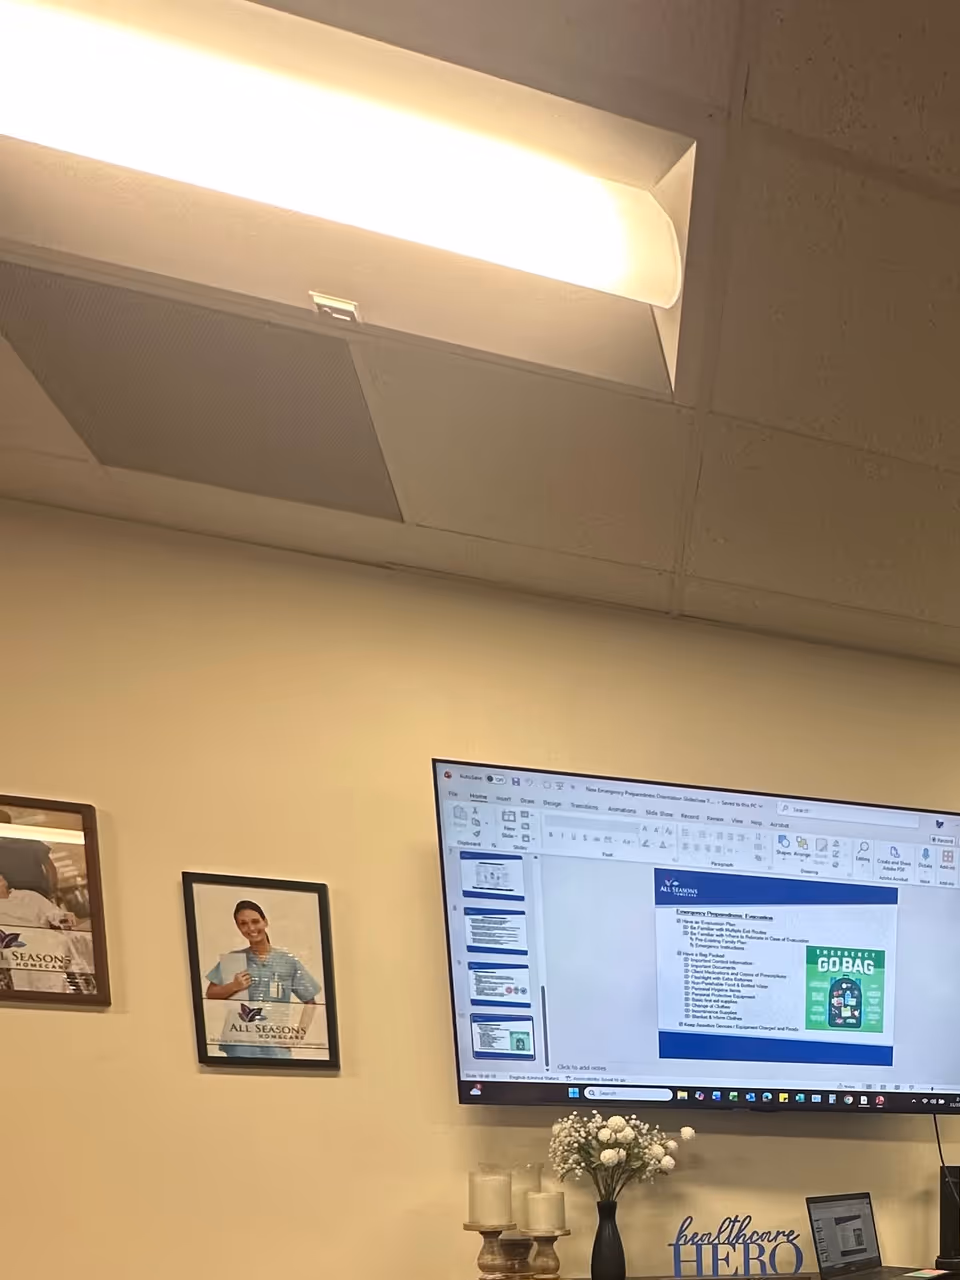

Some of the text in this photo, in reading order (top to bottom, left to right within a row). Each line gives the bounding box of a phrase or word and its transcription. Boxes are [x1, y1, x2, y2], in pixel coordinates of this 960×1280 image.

[672, 887, 698, 895] SEASONS
[11, 951, 72, 965] SEASONS
[817, 949, 876, 959] EMERGENCY
[818, 957, 875, 975] GO BAG
[229, 1023, 307, 1035] ALL SEASONS
[258, 1033, 305, 1041] HOMECARE
[673, 1215, 800, 1247] healthcare
[672, 1240, 804, 1279] HERO
